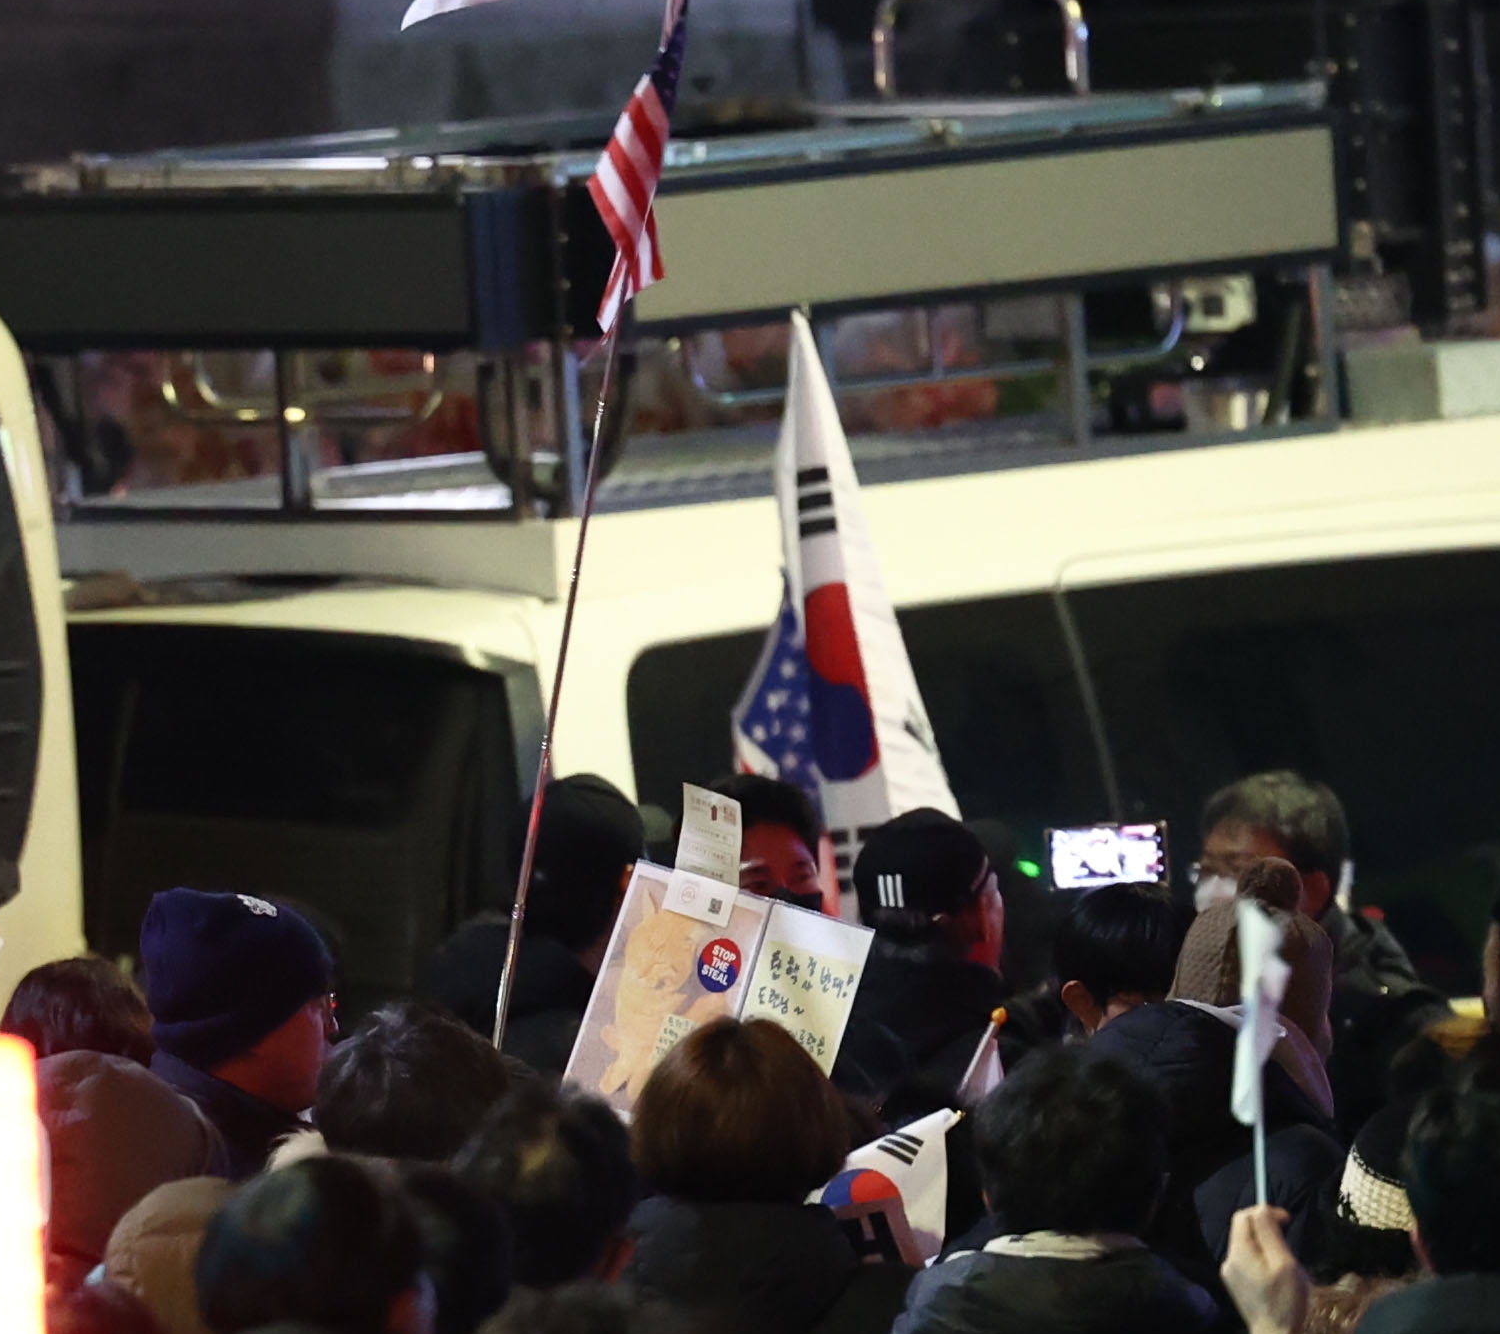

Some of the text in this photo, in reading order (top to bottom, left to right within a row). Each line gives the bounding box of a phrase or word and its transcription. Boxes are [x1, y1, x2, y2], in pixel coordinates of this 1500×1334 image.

[712, 944, 737, 963] STOP
[711, 957, 730, 972] THE
[700, 965, 729, 987] STEAL
